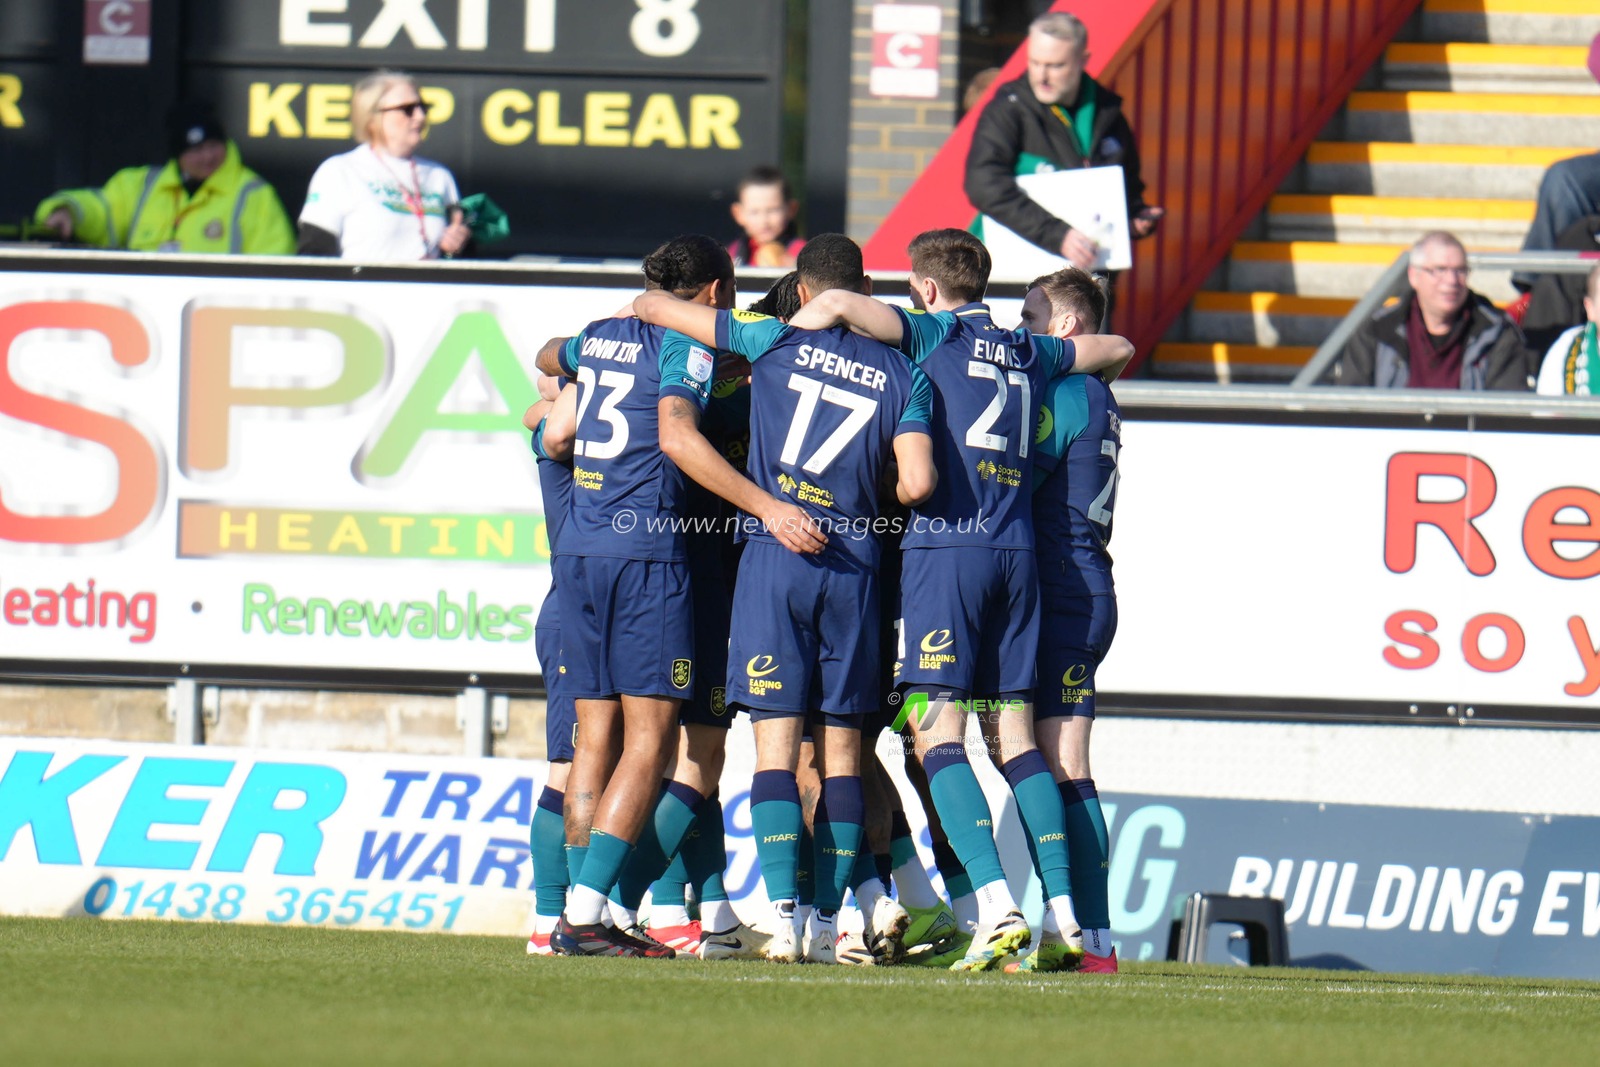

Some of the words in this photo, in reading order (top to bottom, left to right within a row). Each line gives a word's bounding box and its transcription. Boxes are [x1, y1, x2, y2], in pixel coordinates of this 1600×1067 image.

[99, 0, 135, 36] C
[885, 32, 925, 68] C
[247, 82, 455, 141] KEP
[481, 88, 743, 149] CLEAR
[795, 344, 887, 392] SPENCER
[973, 338, 1022, 369] EVANS
[0, 299, 538, 545] SPA
[573, 365, 635, 460] 23
[780, 372, 879, 475] 17
[965, 360, 1031, 459] 21
[577, 479, 603, 491] roker
[996, 473, 1021, 487] Broker
[997, 464, 1022, 478] Sports
[1087, 439, 1121, 527] 2
[797, 490, 834, 508] Broker
[1383, 450, 1600, 581] Re
[3, 578, 157, 643] eating
[242, 582, 535, 642] Renewables
[919, 653, 956, 663] LEADING
[919, 660, 942, 670] EDGE
[749, 678, 783, 690] EADING
[1061, 688, 1094, 697] LEADING
[1061, 695, 1084, 704] EDGE
[0, 750, 348, 877] KER
[763, 833, 798, 843] HTAFC
[822, 847, 856, 857] HTAFC
[1039, 833, 1066, 844] HTAFC
[354, 830, 535, 892] WAR
[83, 876, 247, 921] 01438
[265, 886, 465, 930] 365451
